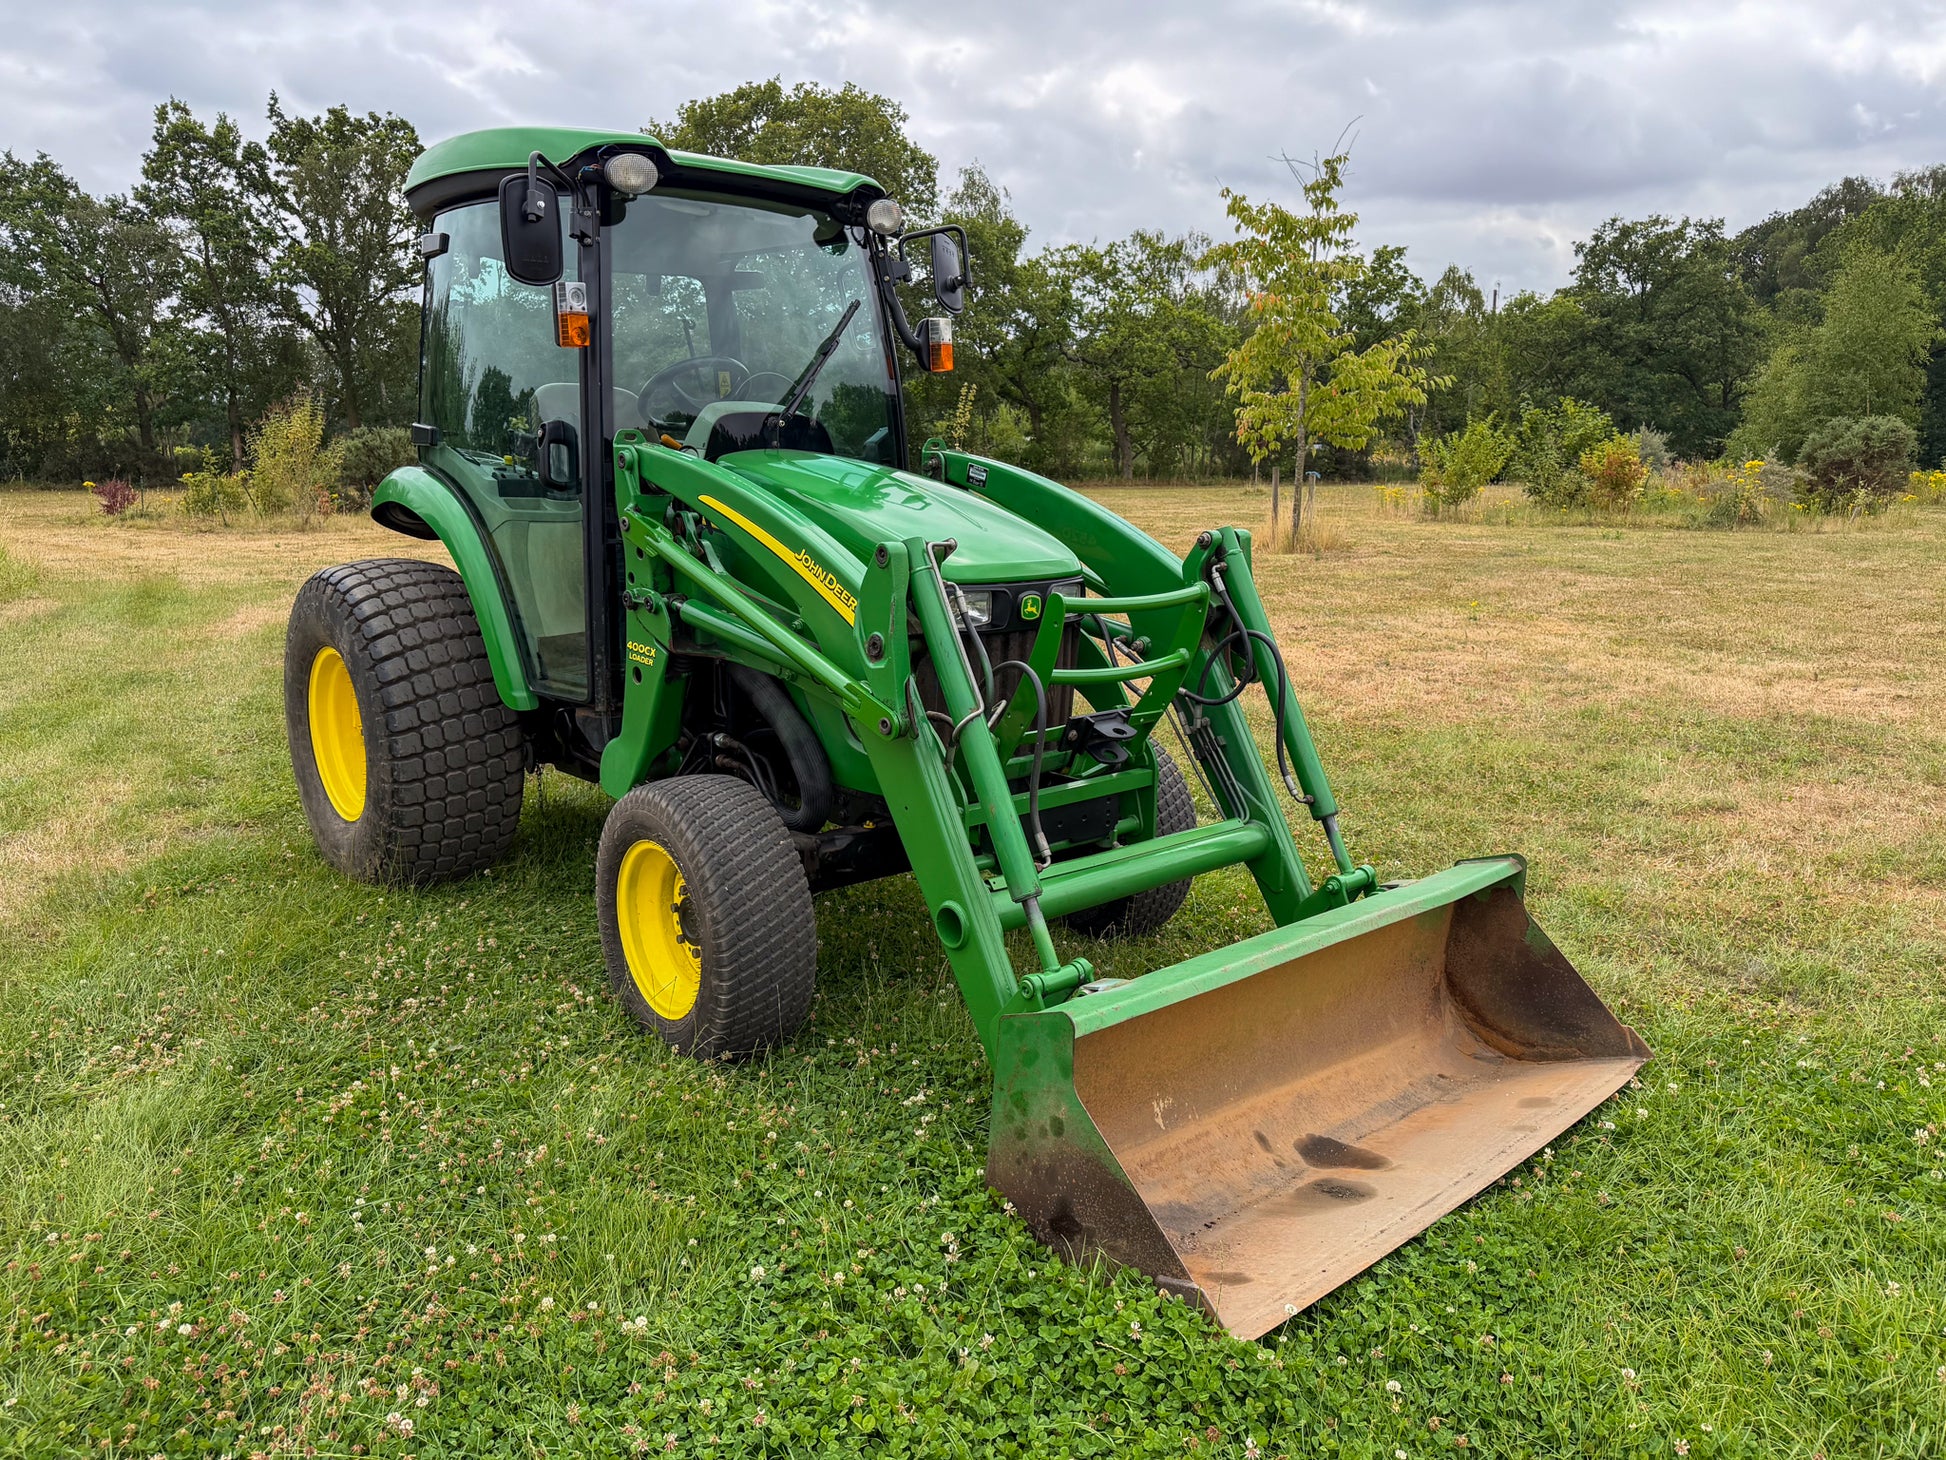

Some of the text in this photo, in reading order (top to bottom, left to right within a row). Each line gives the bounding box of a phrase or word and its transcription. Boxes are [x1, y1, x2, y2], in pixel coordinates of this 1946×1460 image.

[794, 549, 826, 583] JOHN
[627, 641, 656, 657] 400CX
[629, 652, 654, 666] LOADER
